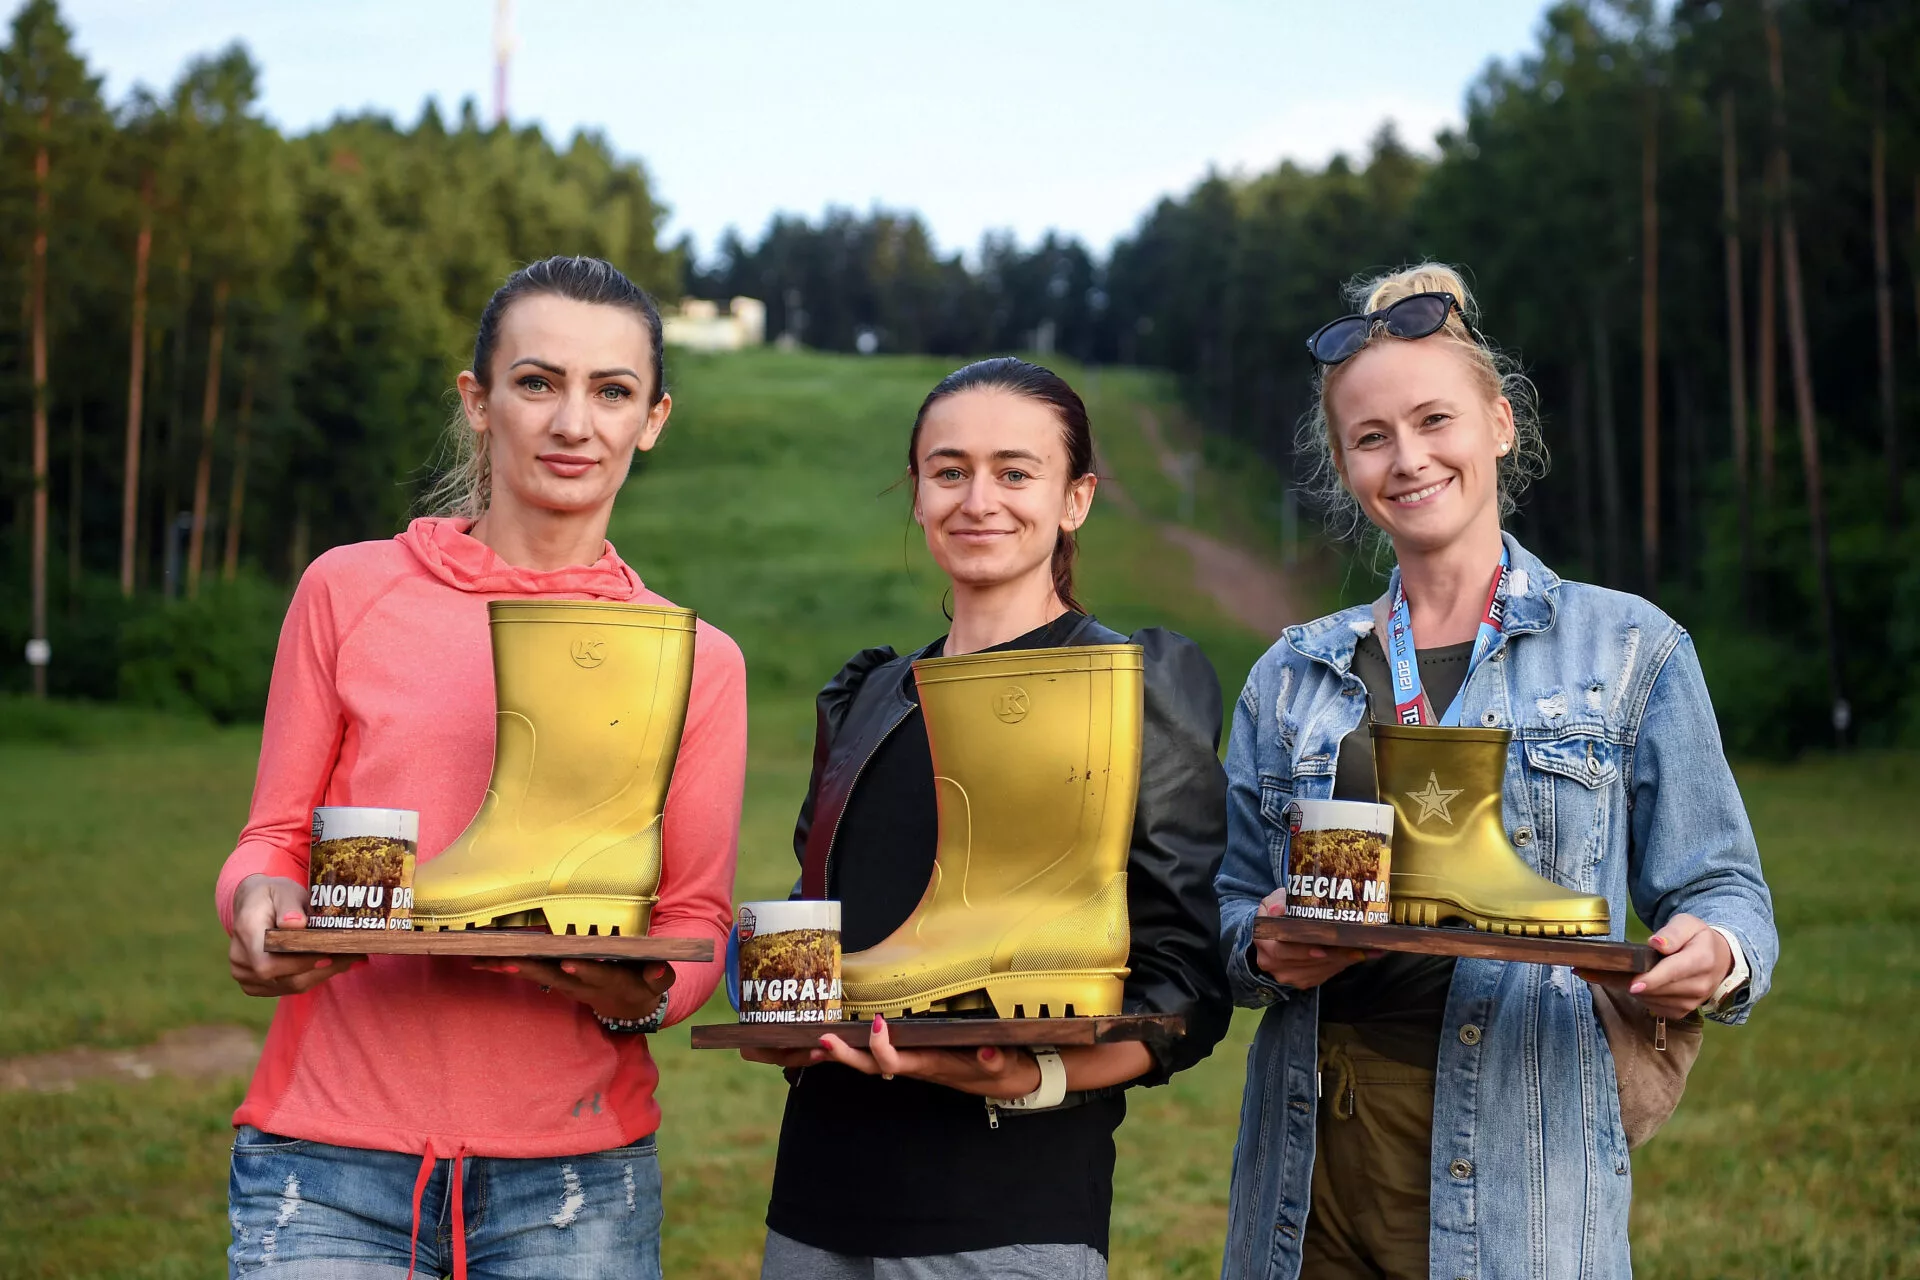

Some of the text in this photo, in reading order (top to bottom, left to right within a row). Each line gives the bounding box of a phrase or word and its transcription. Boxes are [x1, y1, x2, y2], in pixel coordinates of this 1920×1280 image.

[1394, 614, 1406, 656] TRAIL
[1397, 660, 1413, 691] 2021
[999, 694, 1025, 716] K
[310, 884, 383, 908] ZNOWU
[1363, 880, 1386, 903] NA
